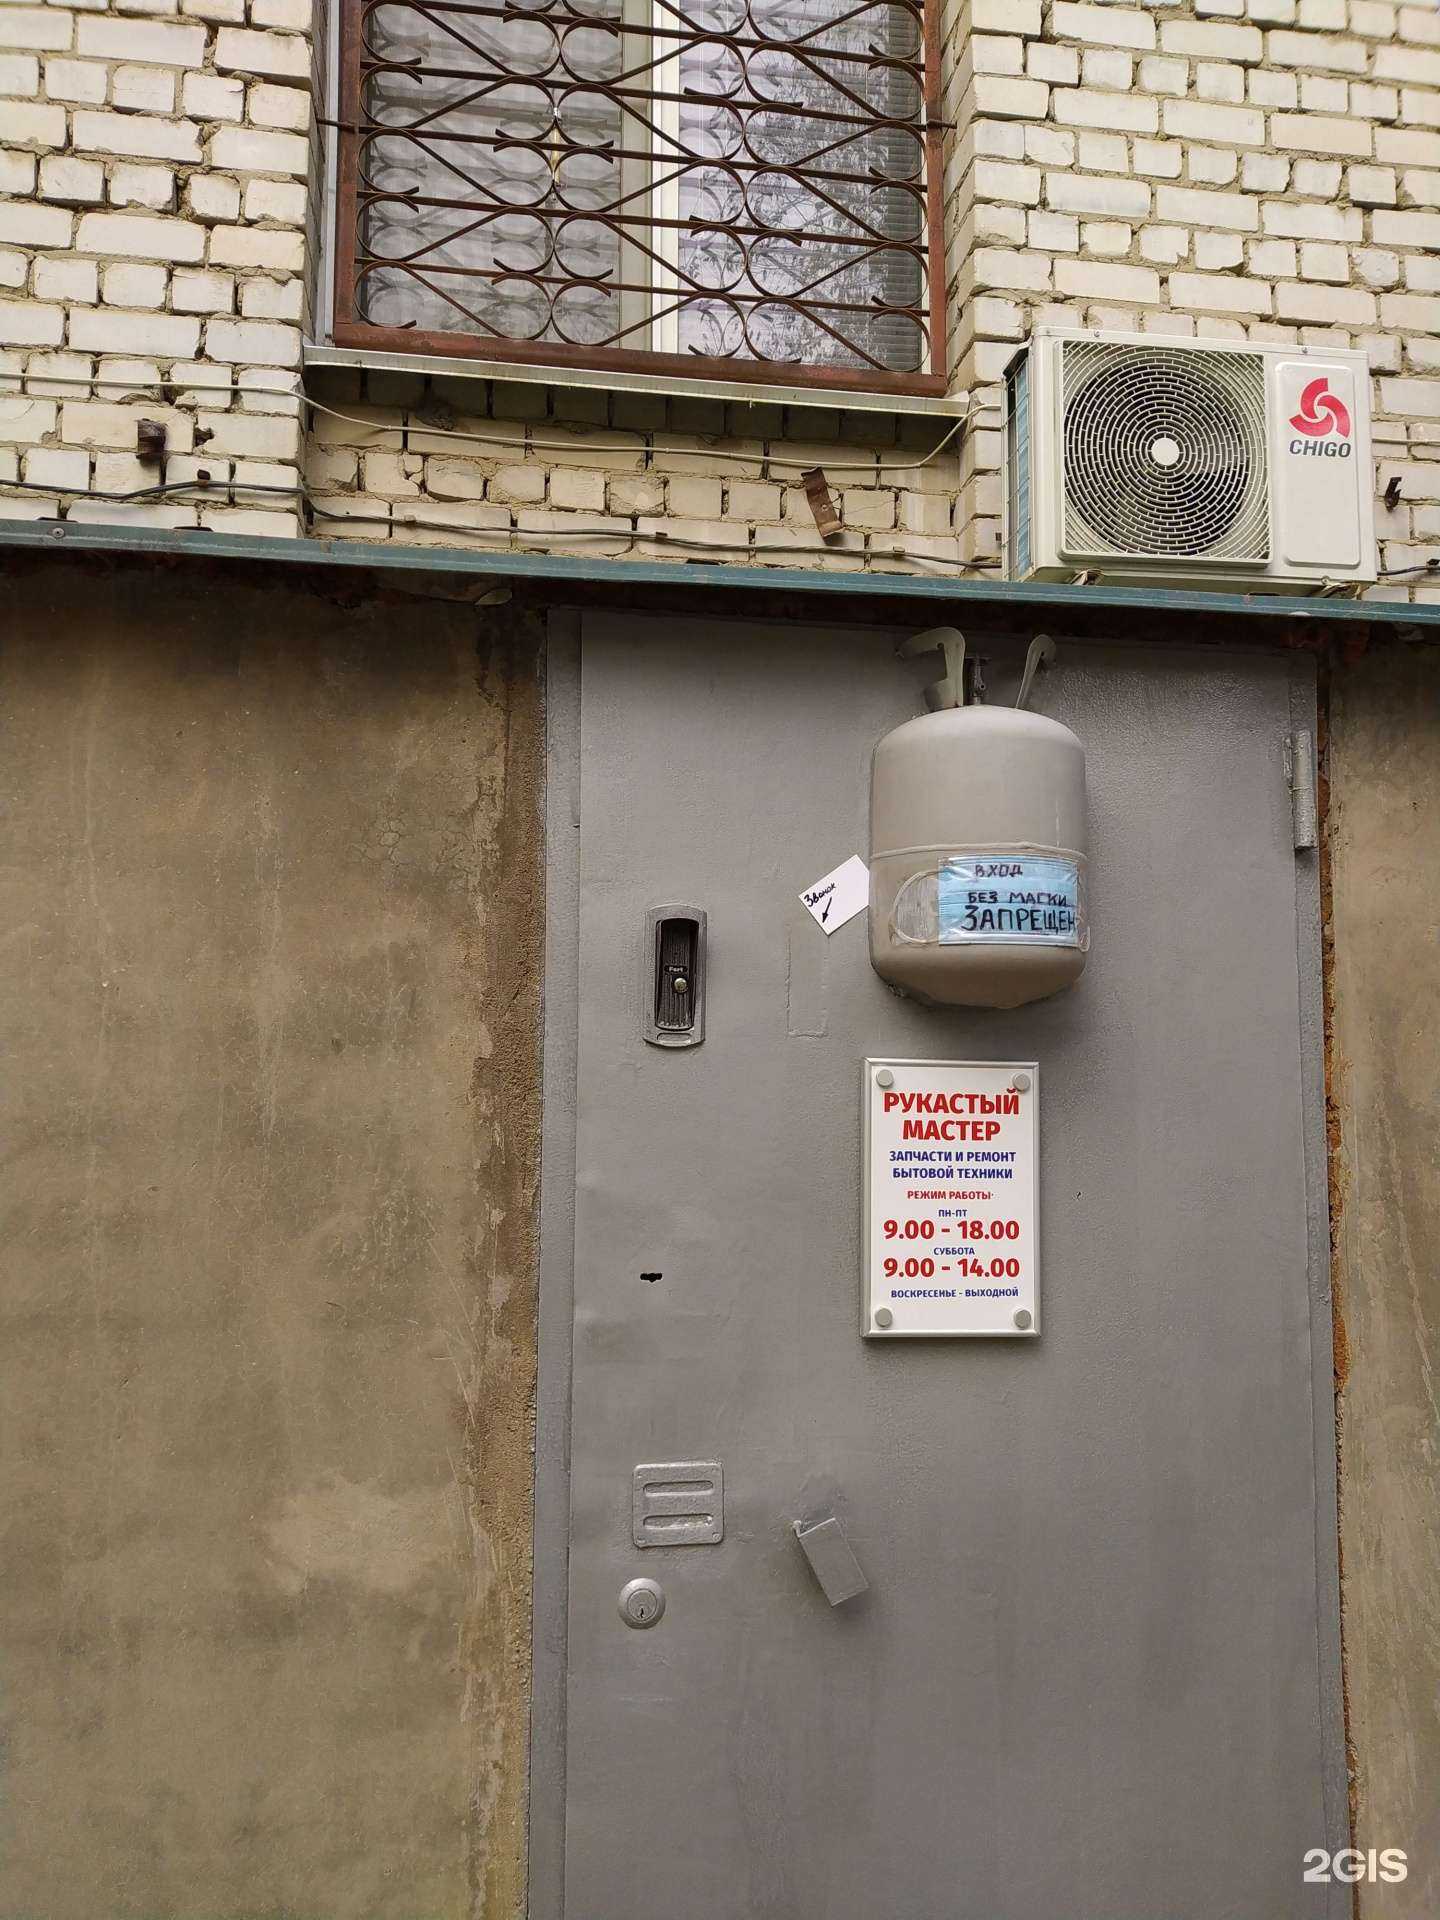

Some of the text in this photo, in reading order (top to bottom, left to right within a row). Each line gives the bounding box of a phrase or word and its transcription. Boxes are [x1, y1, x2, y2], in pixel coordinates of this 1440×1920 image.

[1289, 439, 1350, 458] CHIGO
[974, 864, 1023, 877] ВХОД
[968, 891, 1067, 907] БЕЗ МАСКИ
[961, 905, 1076, 934] ЗАПРЕЩЕН
[883, 1087, 1020, 1114] РУКАСТЫЙ
[902, 1119, 1001, 1141] МАСТЕР
[889, 1150, 1017, 1163] ЗАПЧАСТИ И РЕМОНТ
[892, 1165, 1013, 1179] БЫТОВОЙ ТЕХНИКИ
[907, 1190, 946, 1200] РЕЖИМ
[938, 1209, 968, 1218] ПН-ПТ
[883, 1219, 935, 1240] 9.00
[957, 1220, 1020, 1240] 18.00
[933, 1247, 975, 1256] СУББОТА
[883, 1257, 935, 1278] 9.00
[957, 1257, 1020, 1278] 14.00
[890, 1289, 957, 1298] ВОСКРЕСЕНЬЕ
[965, 1286, 1019, 1298] ВЫХОДНОЙ
